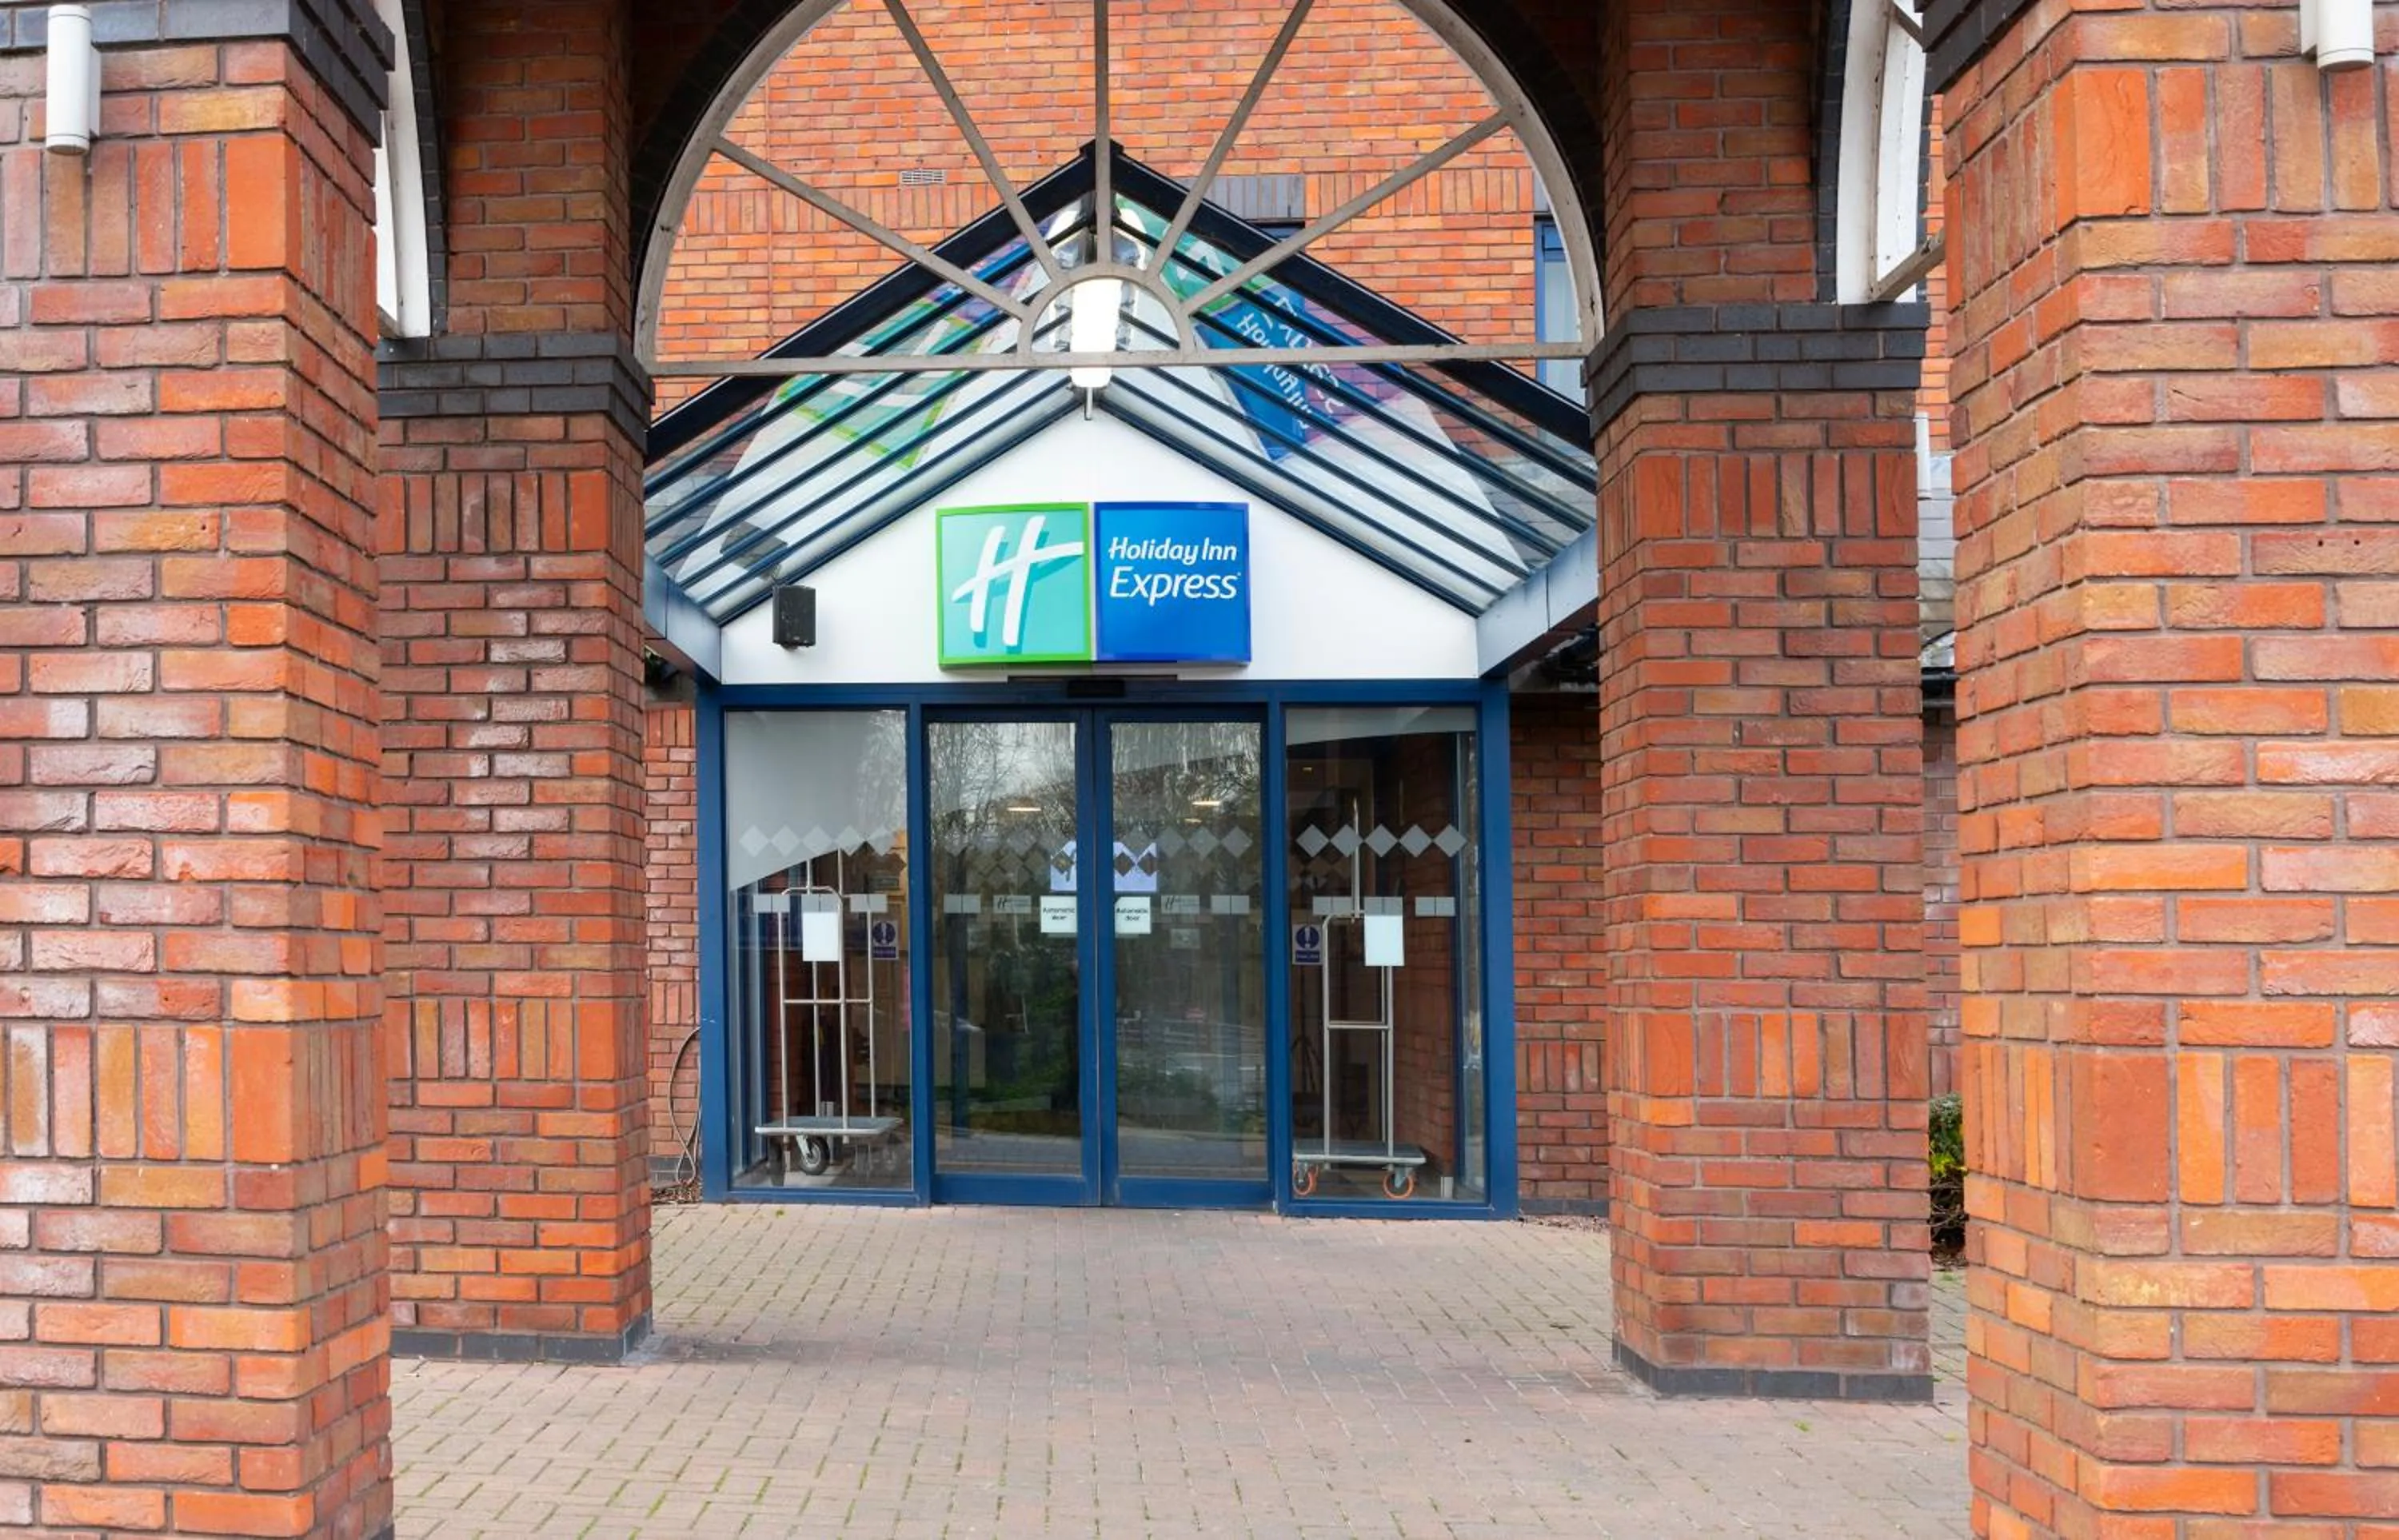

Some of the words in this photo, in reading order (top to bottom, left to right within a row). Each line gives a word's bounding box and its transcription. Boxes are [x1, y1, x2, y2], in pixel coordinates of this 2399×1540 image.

[1108, 537, 1198, 566] Holiday
[1201, 537, 1238, 561] Inn
[951, 514, 1084, 647] H
[1109, 565, 1240, 606] Express
